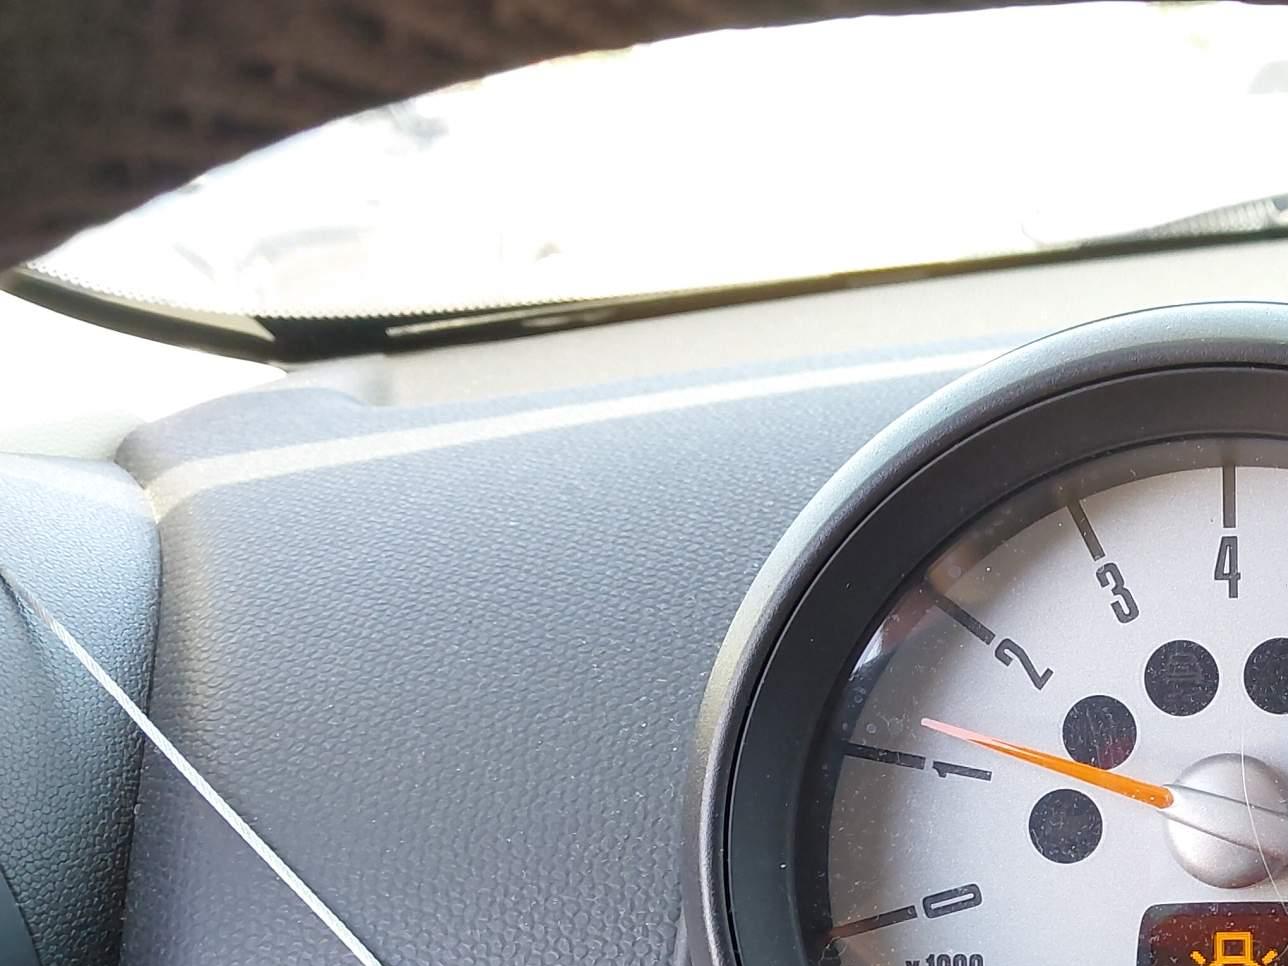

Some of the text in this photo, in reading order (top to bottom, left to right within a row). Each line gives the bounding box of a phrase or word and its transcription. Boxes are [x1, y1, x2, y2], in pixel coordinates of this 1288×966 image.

[1095, 562, 1140, 624] 3
[1213, 535, 1241, 599] 4
[994, 637, 1054, 690] 2
[932, 761, 992, 781] 1
[922, 883, 983, 918] 0
